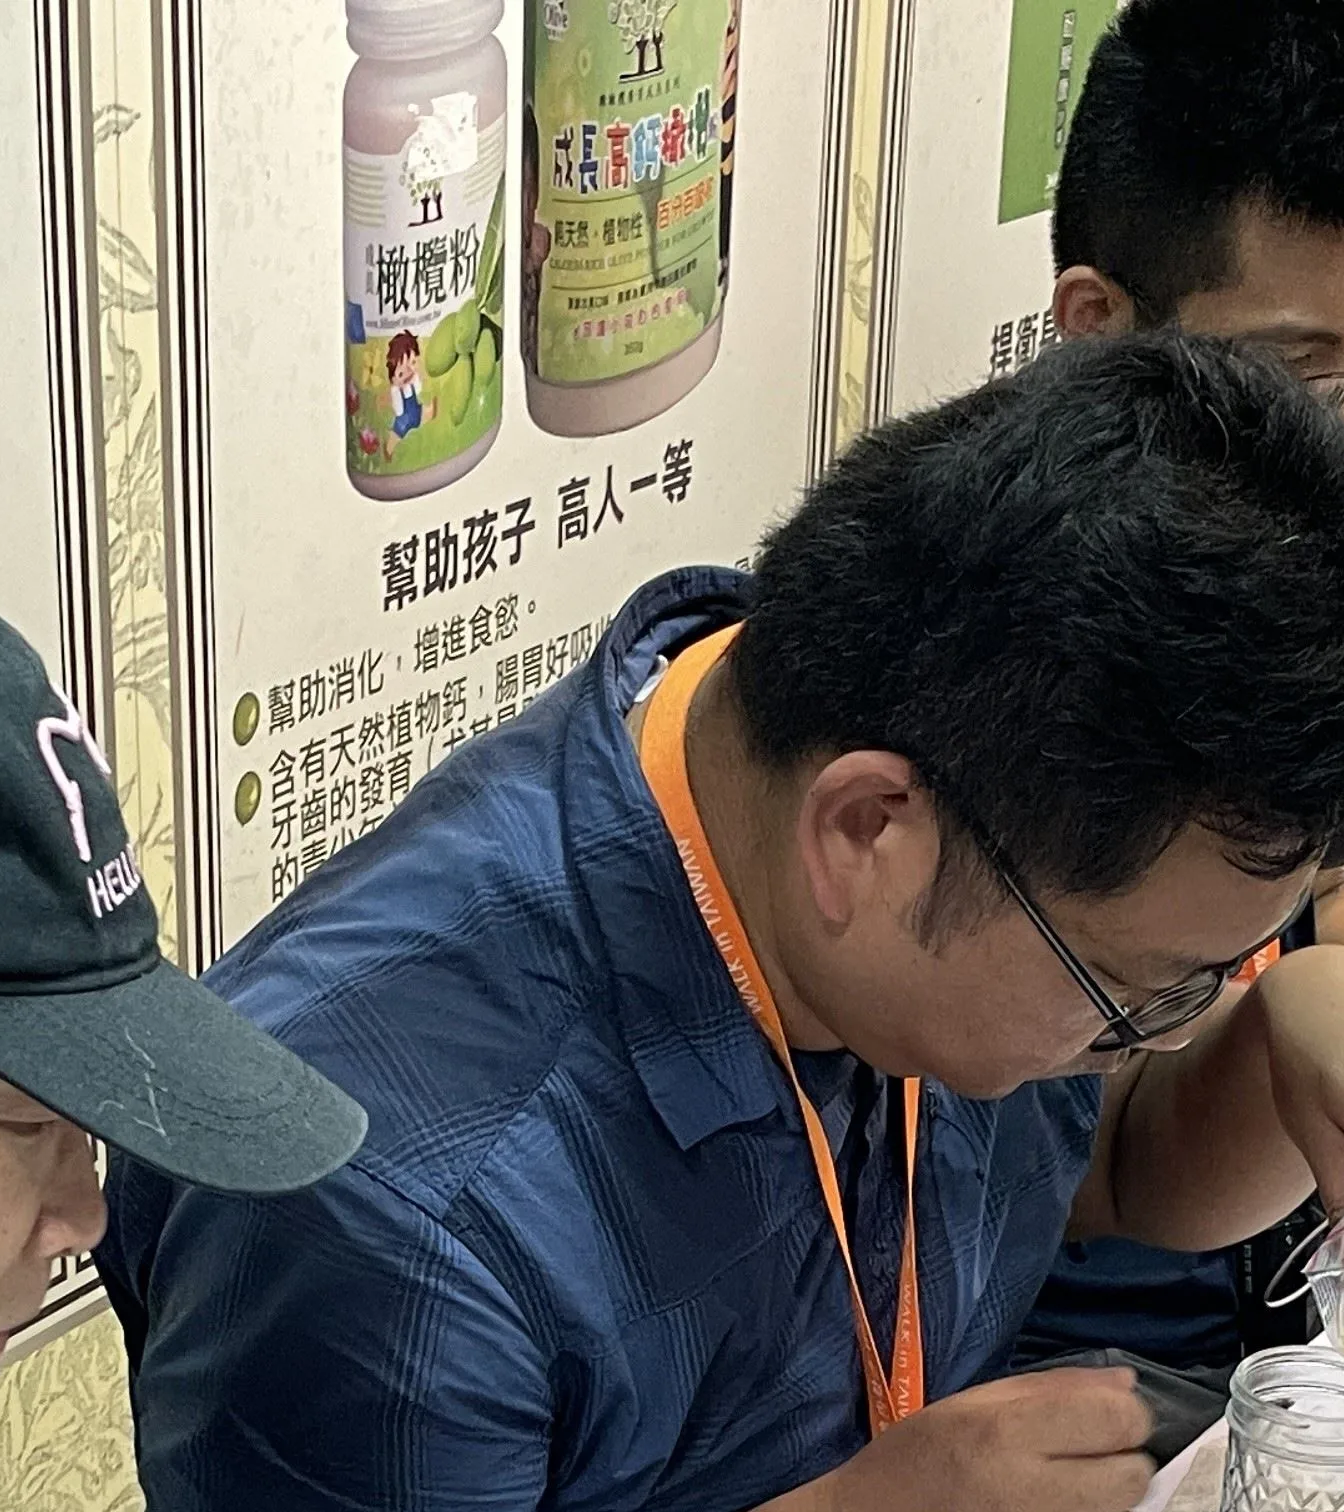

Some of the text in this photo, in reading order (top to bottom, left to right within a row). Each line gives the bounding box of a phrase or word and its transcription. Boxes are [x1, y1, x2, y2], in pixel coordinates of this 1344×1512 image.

[377, 223, 480, 316] 橄欖粉
[381, 438, 694, 613] 幫助孩子 高人一等
[268, 592, 537, 737] 幫助消化，增進食慾。
[87, 843, 141, 919] HELL
[677, 837, 764, 1014] WALK in TAIWAN
